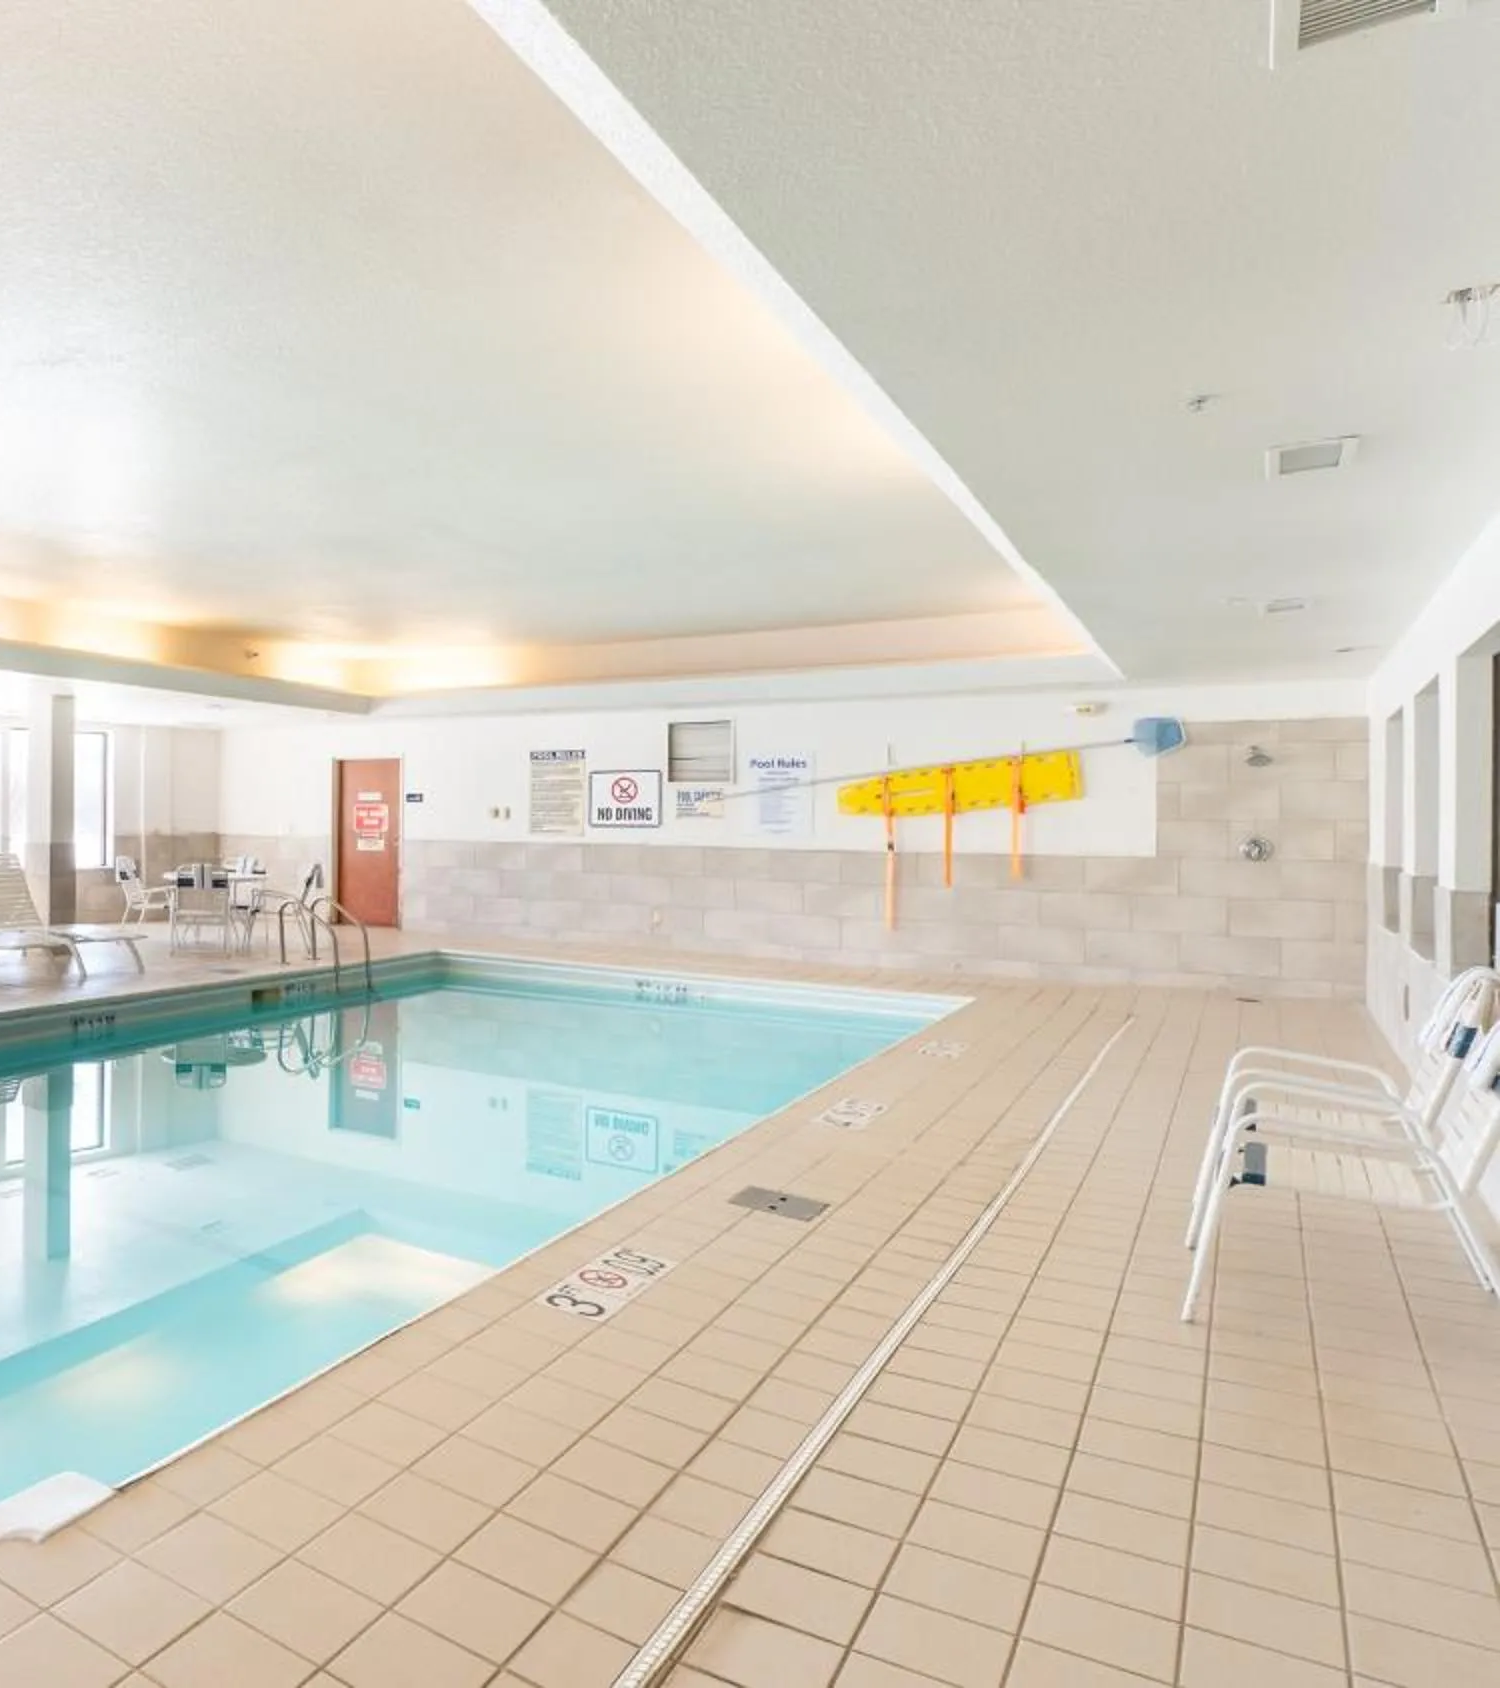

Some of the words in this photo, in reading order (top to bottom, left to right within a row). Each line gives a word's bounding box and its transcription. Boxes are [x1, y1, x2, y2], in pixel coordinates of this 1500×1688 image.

[749, 758, 775, 768] Pool
[777, 757, 807, 768] Rules
[597, 807, 613, 821] NO
[615, 807, 653, 821] DIVING
